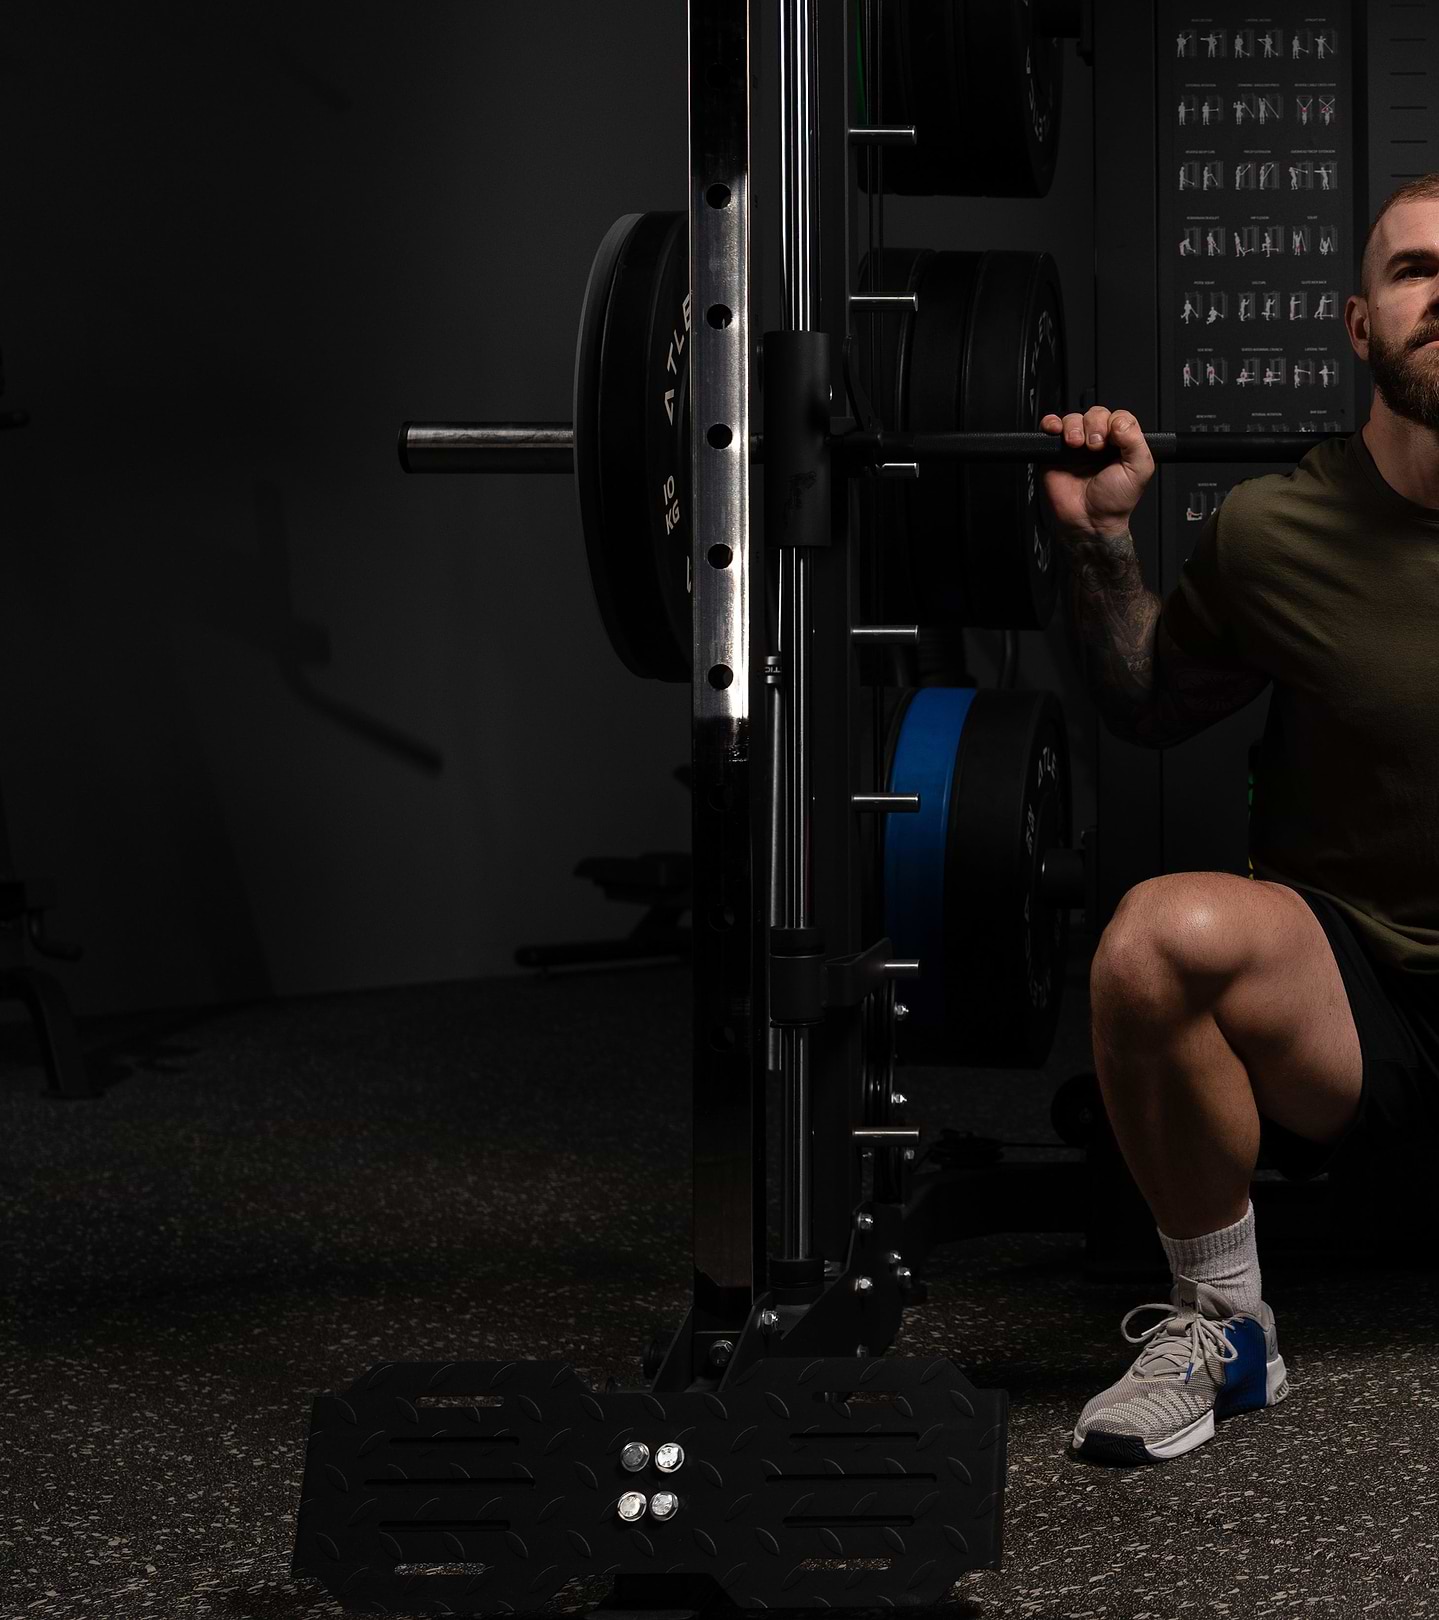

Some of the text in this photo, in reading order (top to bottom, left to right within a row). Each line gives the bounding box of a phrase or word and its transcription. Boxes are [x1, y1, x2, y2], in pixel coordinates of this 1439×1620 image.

[664, 293, 691, 426] ATLE
[663, 475, 675, 505] 10
[665, 499, 680, 535] KG
